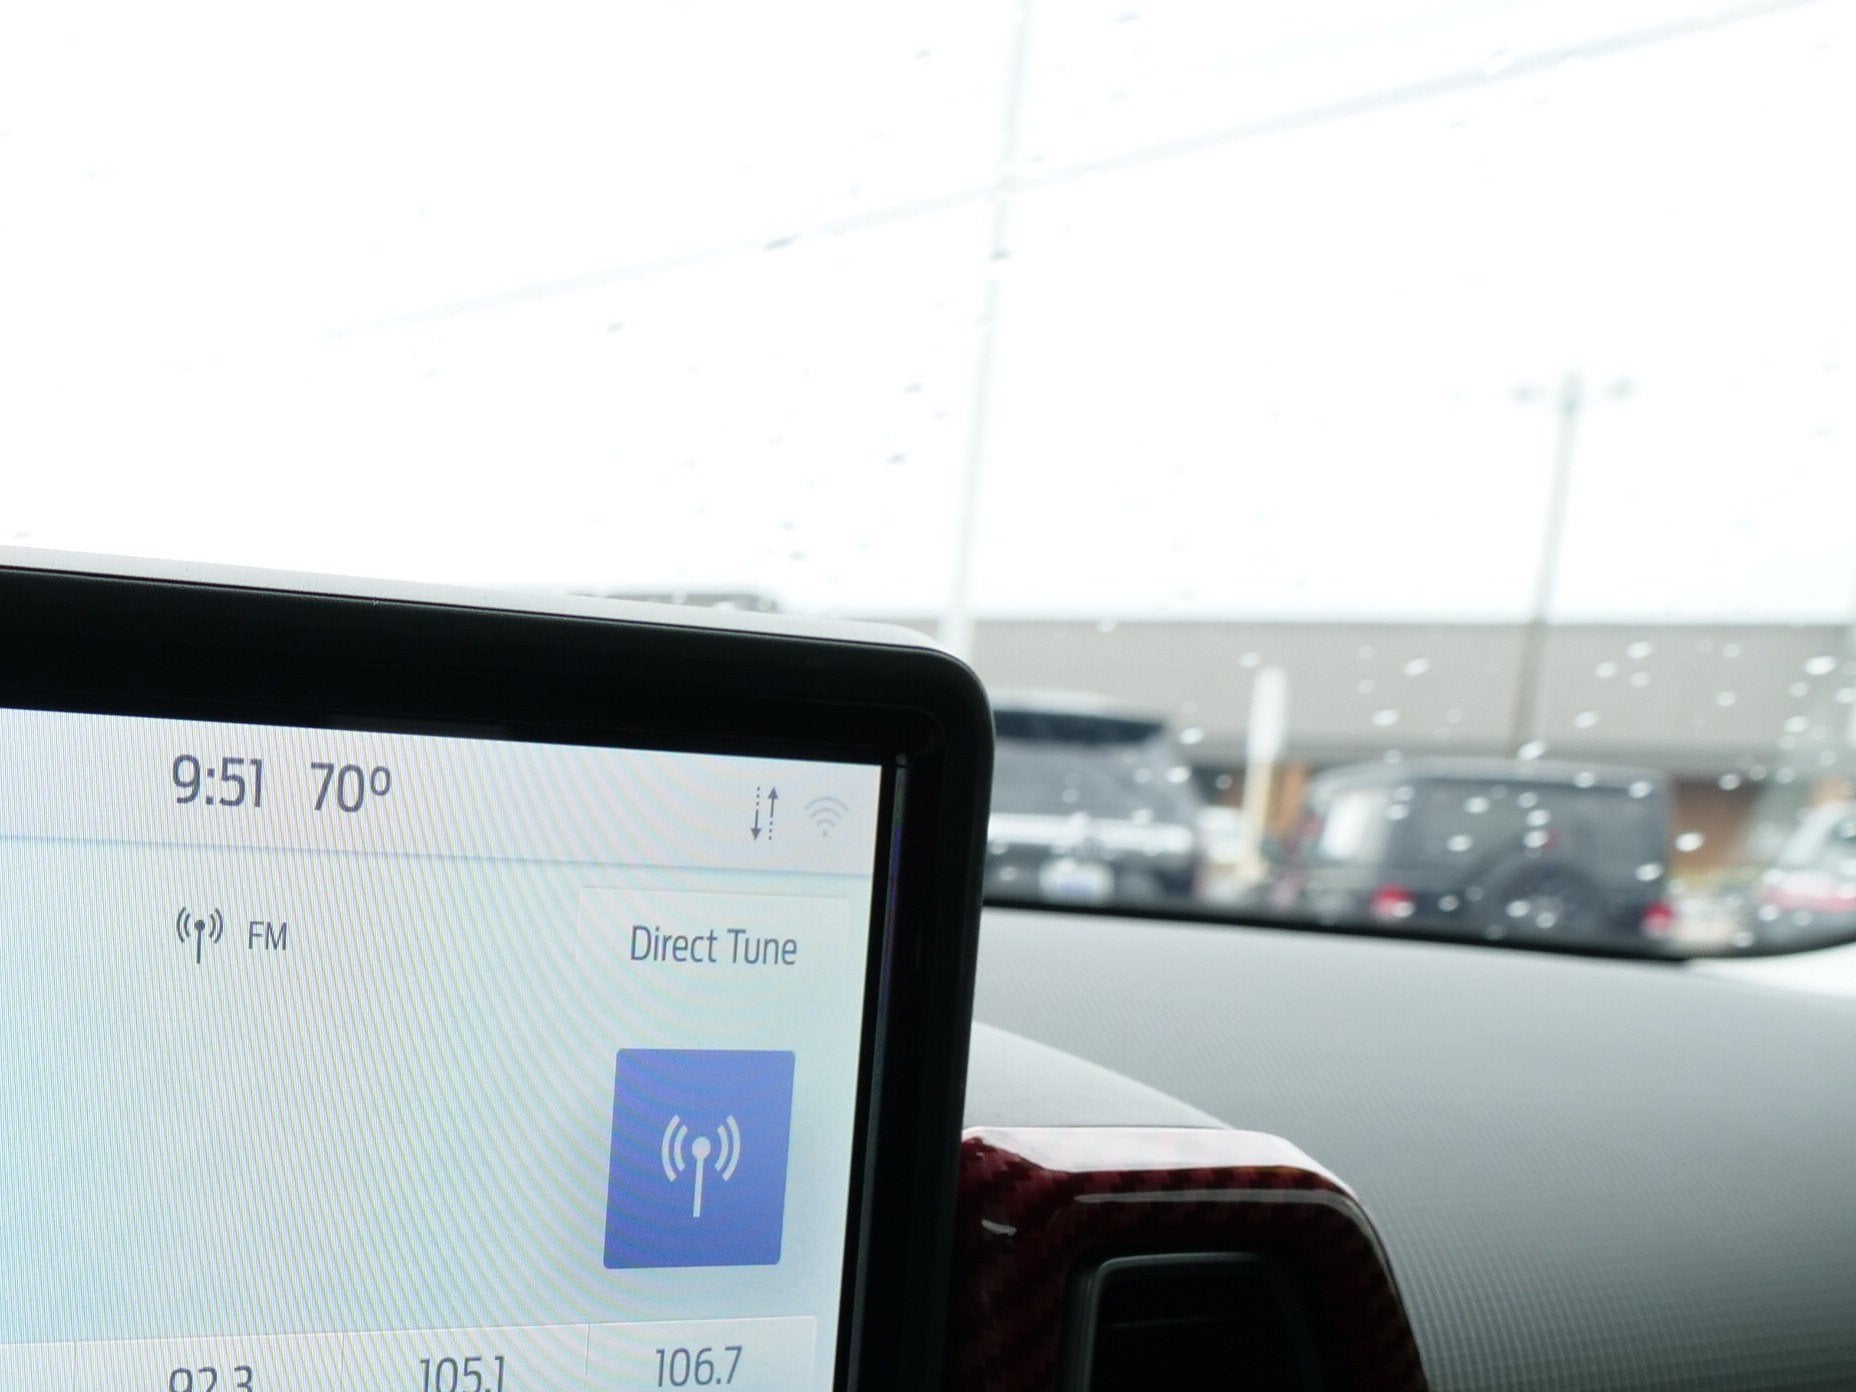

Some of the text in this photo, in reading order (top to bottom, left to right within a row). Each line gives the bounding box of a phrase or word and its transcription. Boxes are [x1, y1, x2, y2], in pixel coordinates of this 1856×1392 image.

[171, 754, 264, 808] 9:51
[247, 920, 289, 952] FM
[629, 925, 798, 966] Direct Tune
[654, 1345, 744, 1388] 106.7
